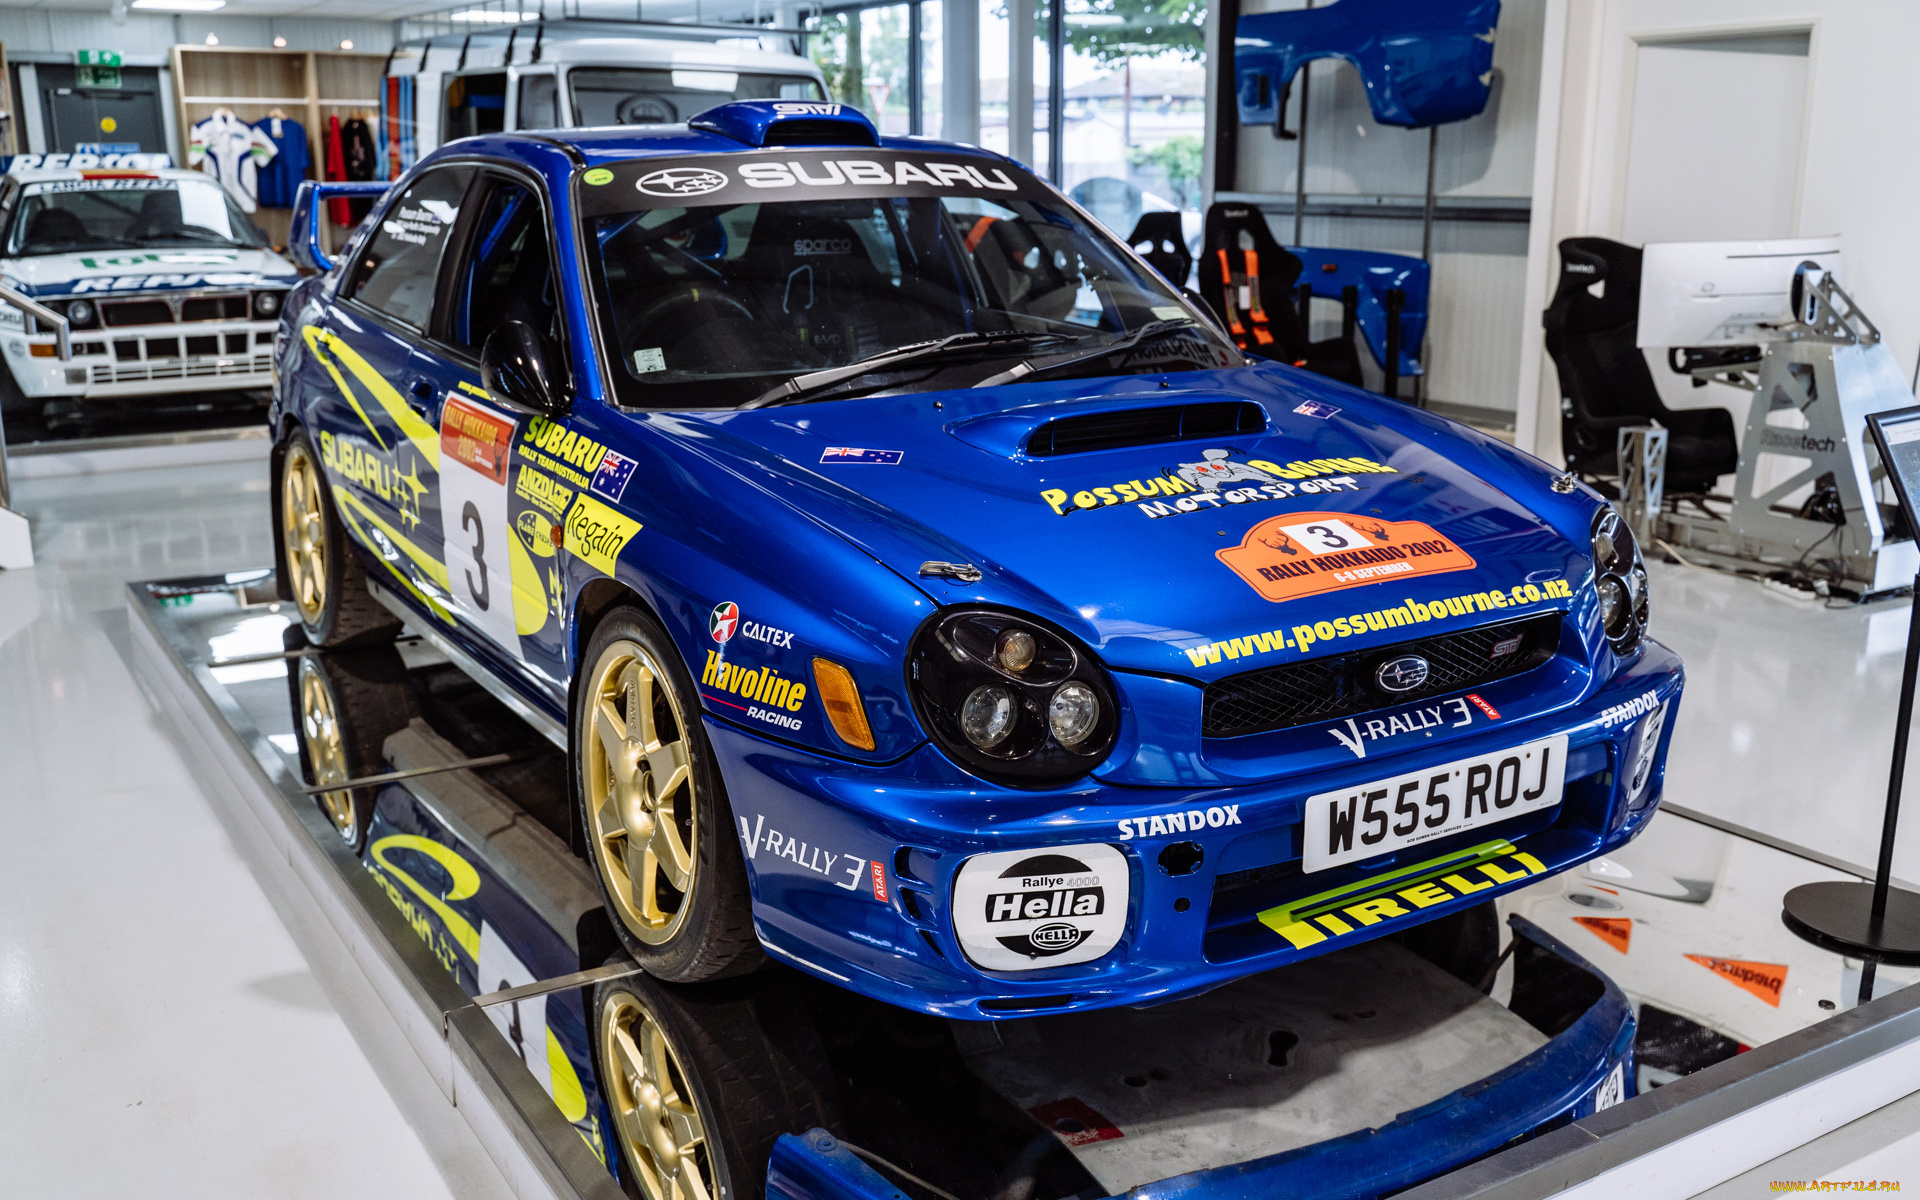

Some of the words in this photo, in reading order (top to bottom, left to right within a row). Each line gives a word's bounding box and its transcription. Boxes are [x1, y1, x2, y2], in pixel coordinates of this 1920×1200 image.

[737, 160, 1018, 191] SUBARU
[794, 240, 852, 256] sparco
[523, 415, 608, 473] SUBARU
[321, 430, 392, 501] SUBARU
[518, 444, 539, 462] RALLY
[537, 453, 557, 472] TEAM
[555, 462, 590, 490] AUSTRALIA
[1040, 475, 1197, 516] POSSUM
[1138, 476, 1360, 520] MOTORSPORT
[567, 503, 624, 560] Regain
[1306, 525, 1349, 548] 3
[462, 500, 489, 612] 3
[1256, 560, 1316, 581] RALLY
[1310, 546, 1407, 571] HOKKAIDO
[1401, 539, 1454, 557] 2002
[1333, 571, 1356, 582] 6-8
[1354, 561, 1415, 579] SEPTEMBER
[742, 621, 795, 649] CALTEX
[1185, 579, 1573, 668] www.possumbourne.co.nz
[701, 649, 807, 712] Havoline
[746, 705, 803, 731] RACING
[1470, 695, 1497, 716] ATARI
[1601, 689, 1660, 729] STANDOX
[1327, 698, 1444, 758] V-RALLY
[1443, 697, 1473, 729] 3
[1328, 773, 1450, 856] W555
[1463, 747, 1550, 819] ROJ
[1118, 805, 1242, 841] STANDOX
[740, 814, 838, 876] V-RALLY
[833, 853, 867, 891] 3
[873, 864, 886, 898] ATARI
[1022, 877, 1064, 888] Rallye
[1066, 875, 1100, 887] 4000
[1257, 838, 1548, 950] PIRELLI
[991, 889, 1099, 921] Hella
[1035, 928, 1078, 941] HELLA
